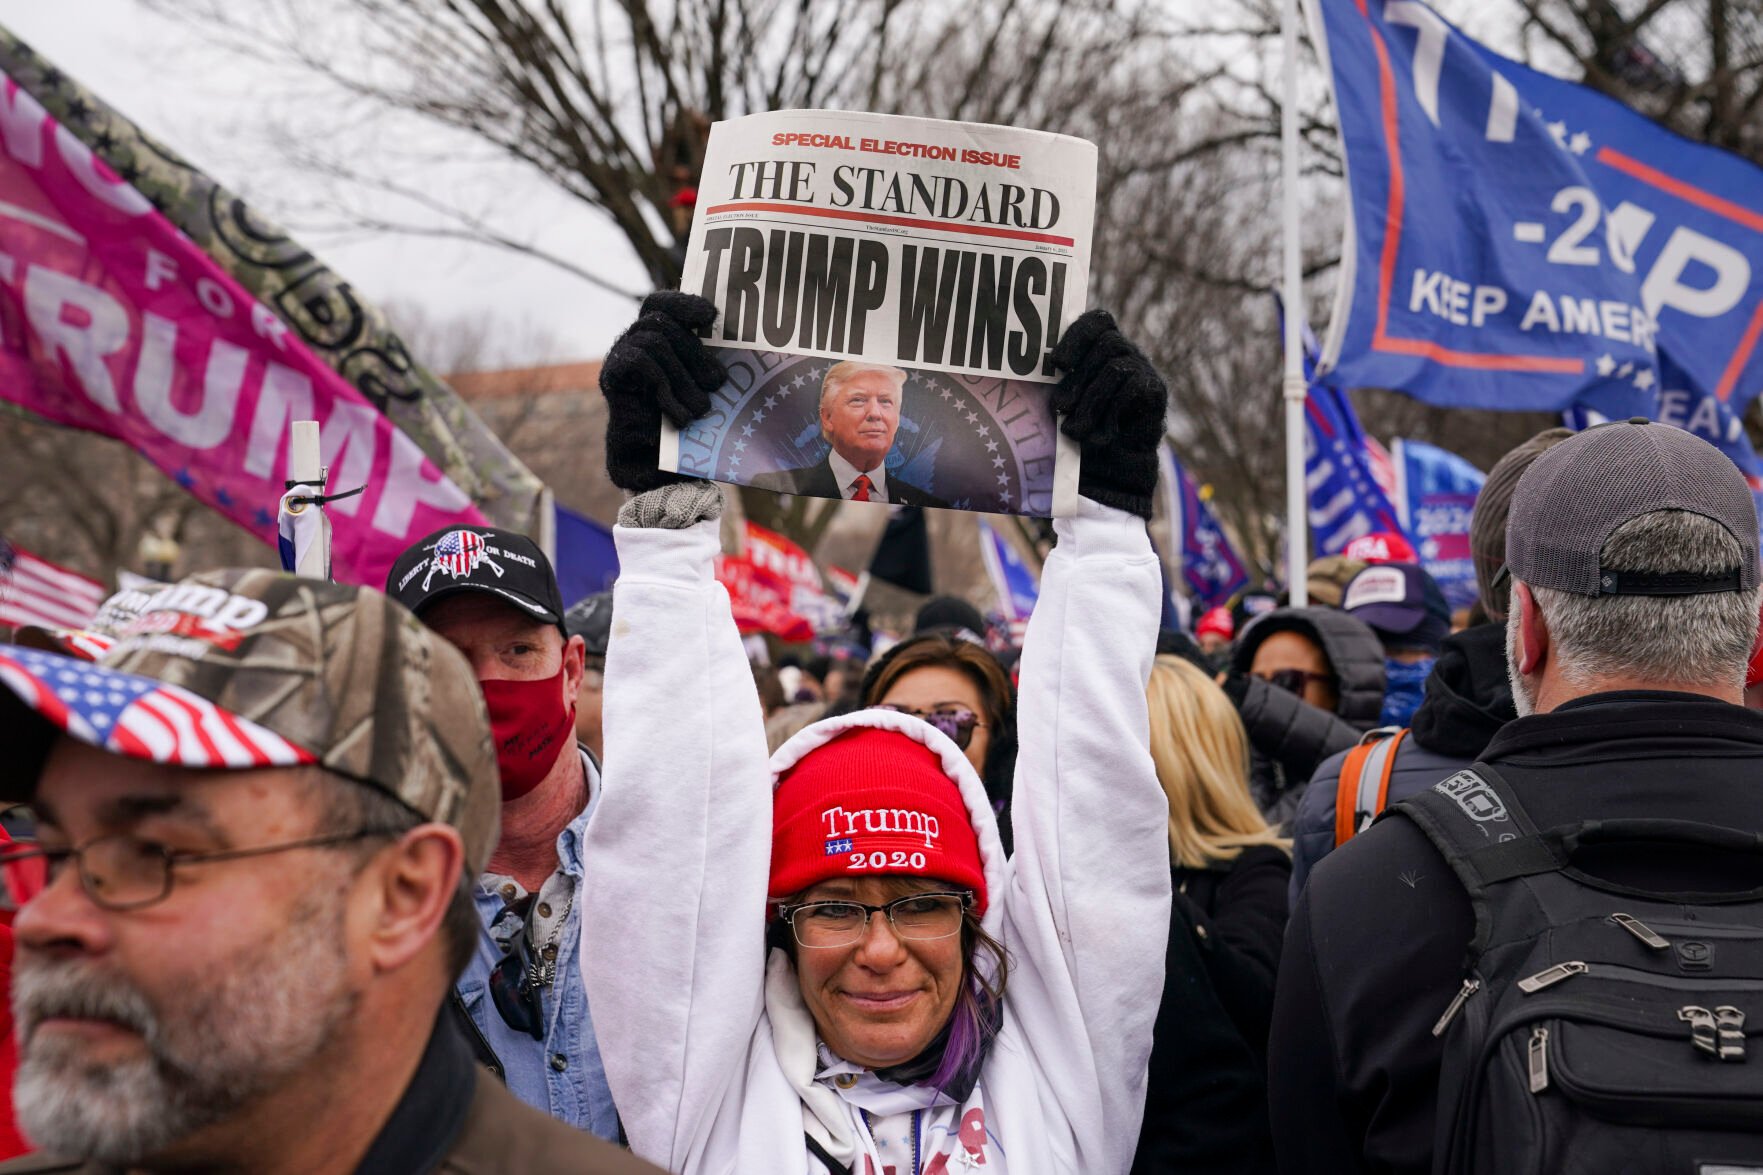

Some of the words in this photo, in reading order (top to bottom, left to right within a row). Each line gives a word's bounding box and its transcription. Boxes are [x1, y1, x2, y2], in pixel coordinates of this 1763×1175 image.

[772, 133, 855, 151] SPECIAL
[860, 138, 957, 161] ELECTION
[961, 149, 1021, 169] ISSUE
[729, 161, 816, 202] THE
[830, 165, 1060, 230] STANDARD
[145, 248, 287, 351] FOR
[700, 227, 889, 356] TRUMP
[897, 243, 1067, 377] WINS!
[0, 253, 471, 538] RUMP
[679, 349, 803, 478] RESIDE
[399, 558, 430, 592] LIBERTY
[486, 545, 500, 556] OR
[504, 550, 537, 568] DEATH
[821, 806, 940, 848] Trump
[847, 852, 927, 870] 2020
